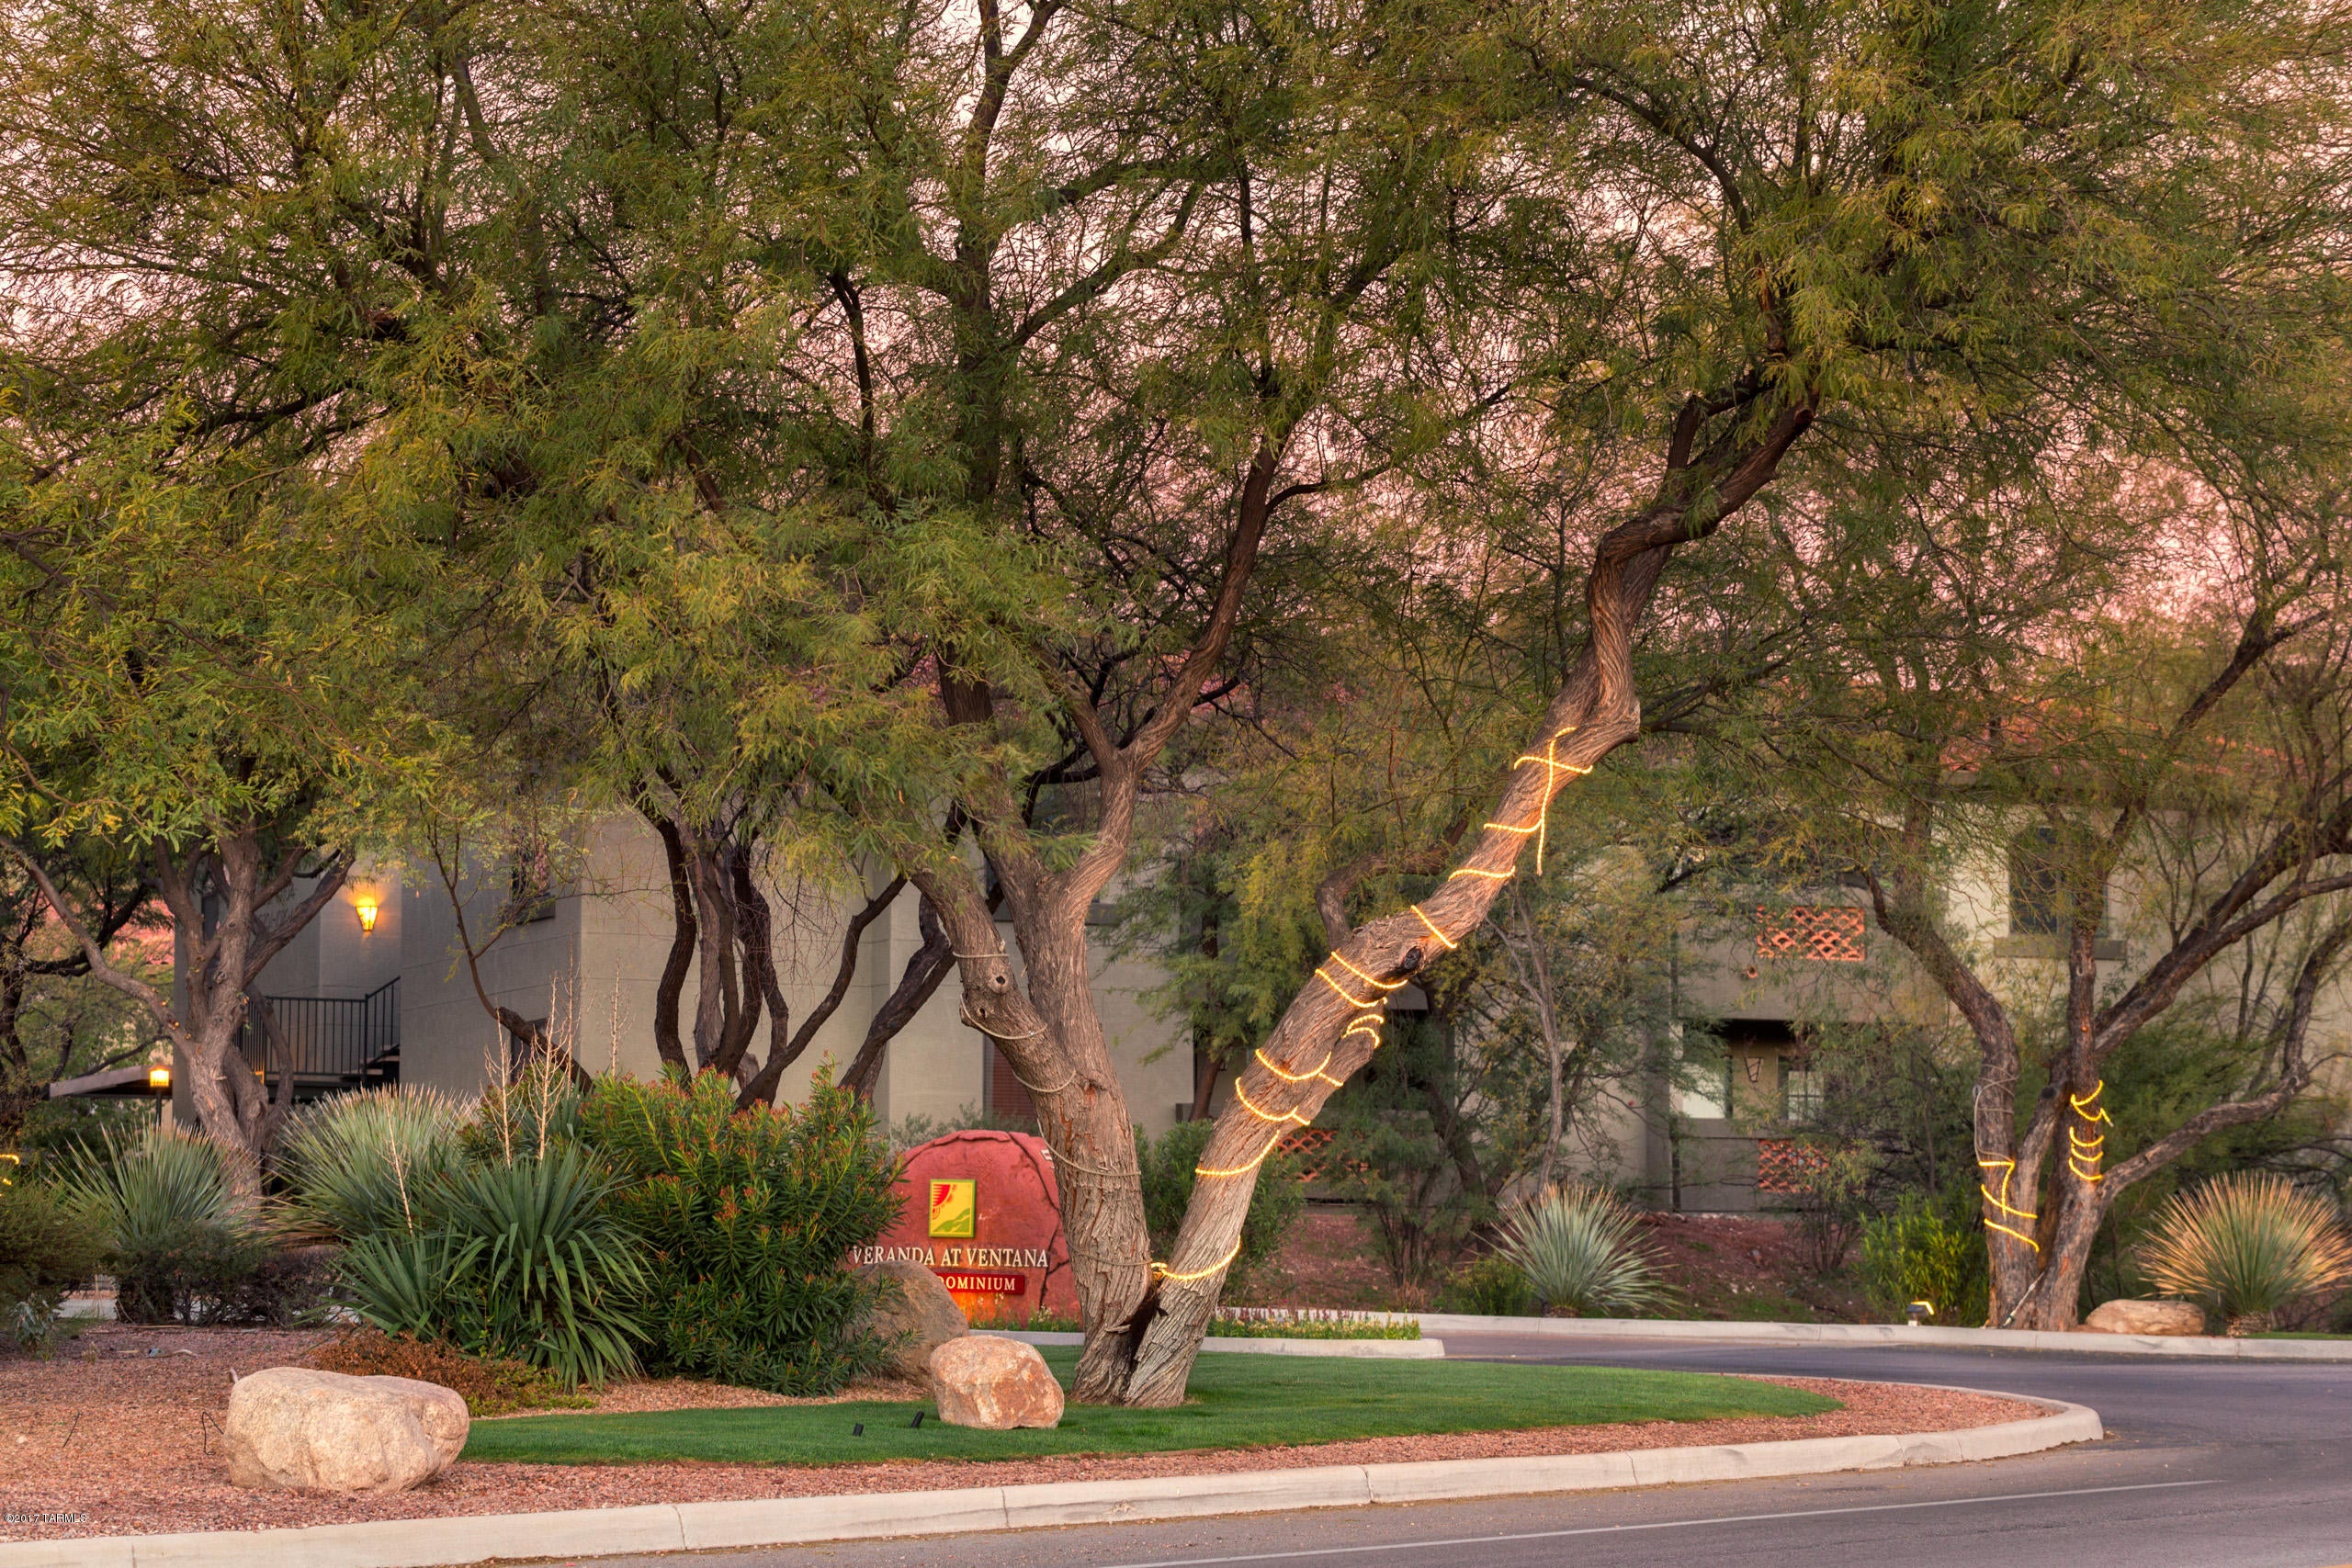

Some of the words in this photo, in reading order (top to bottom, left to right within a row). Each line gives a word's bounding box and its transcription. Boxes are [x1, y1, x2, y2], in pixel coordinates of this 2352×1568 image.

[941, 1247, 961, 1267] AT
[967, 1247, 1049, 1269] VENTANA
[939, 1275, 1016, 1291] OMINIUM
